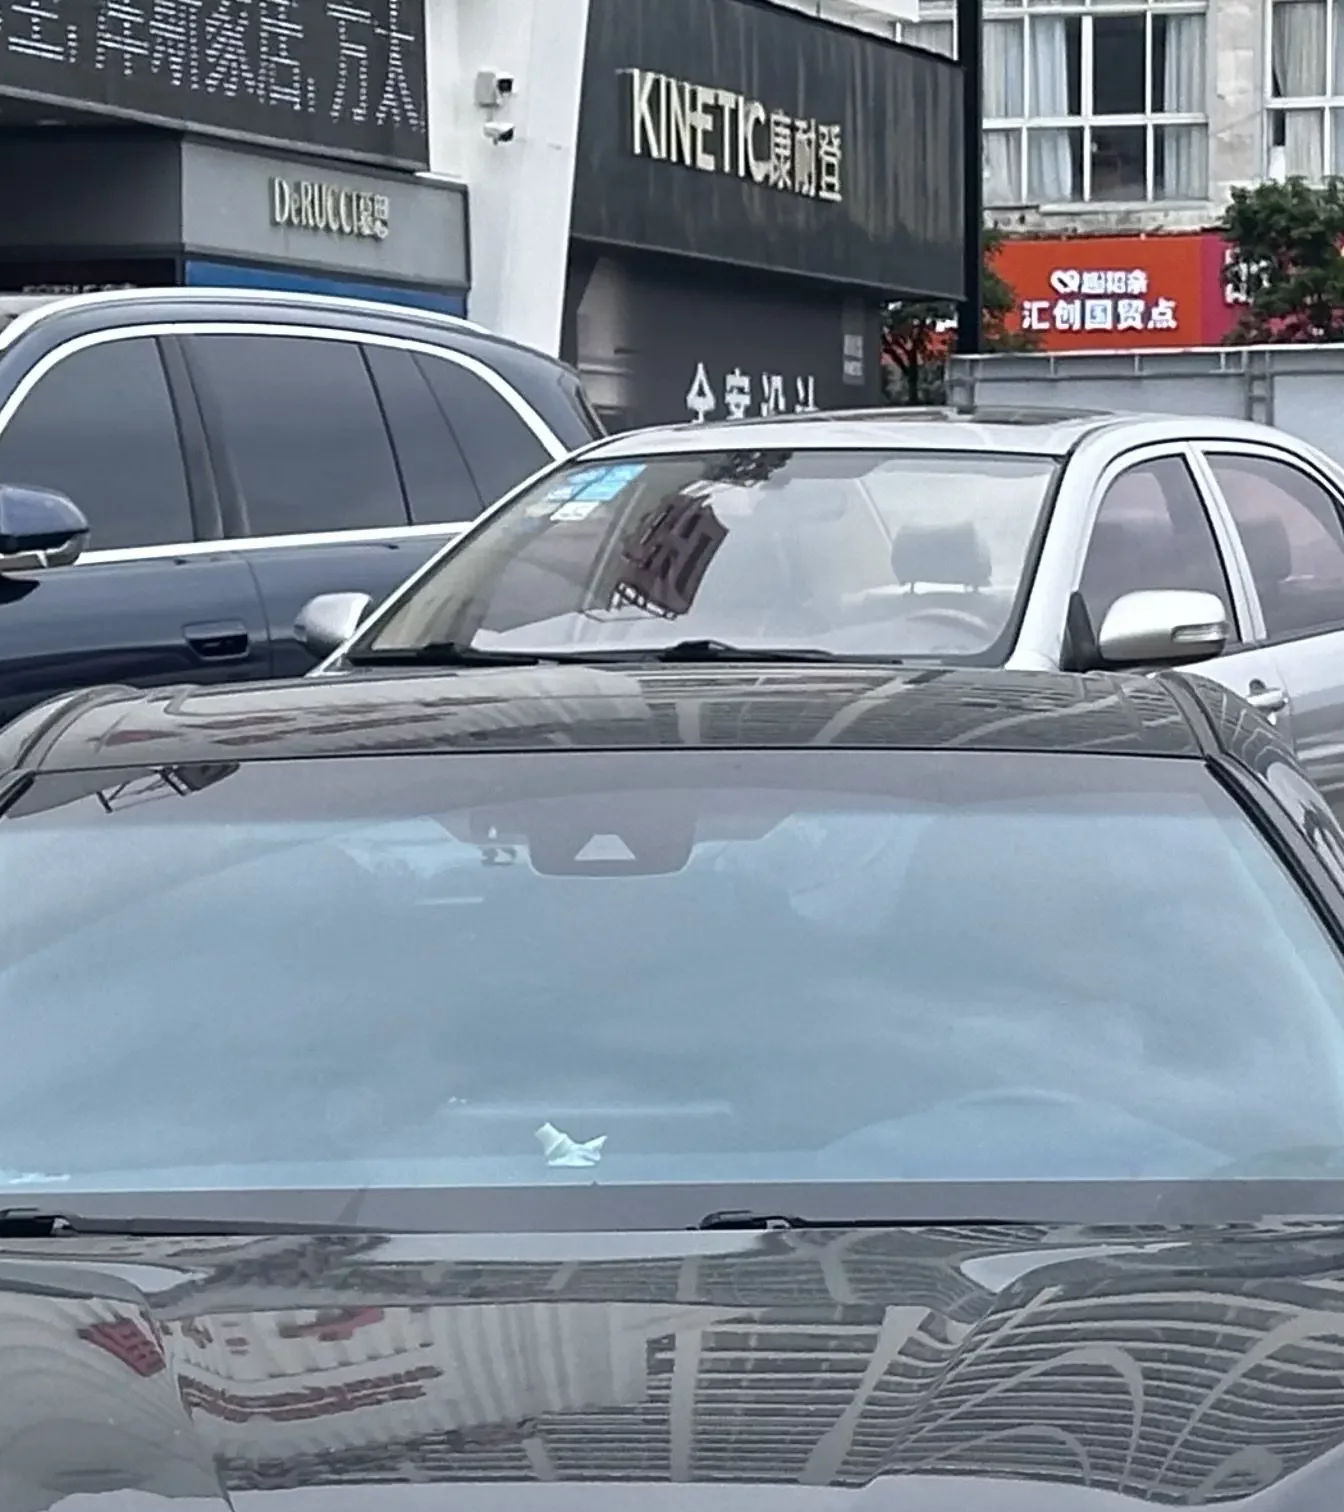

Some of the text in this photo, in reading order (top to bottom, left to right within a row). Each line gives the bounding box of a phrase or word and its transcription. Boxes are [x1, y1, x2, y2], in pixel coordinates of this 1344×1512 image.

[1022, 296, 1178, 331] 汇创国贸点
